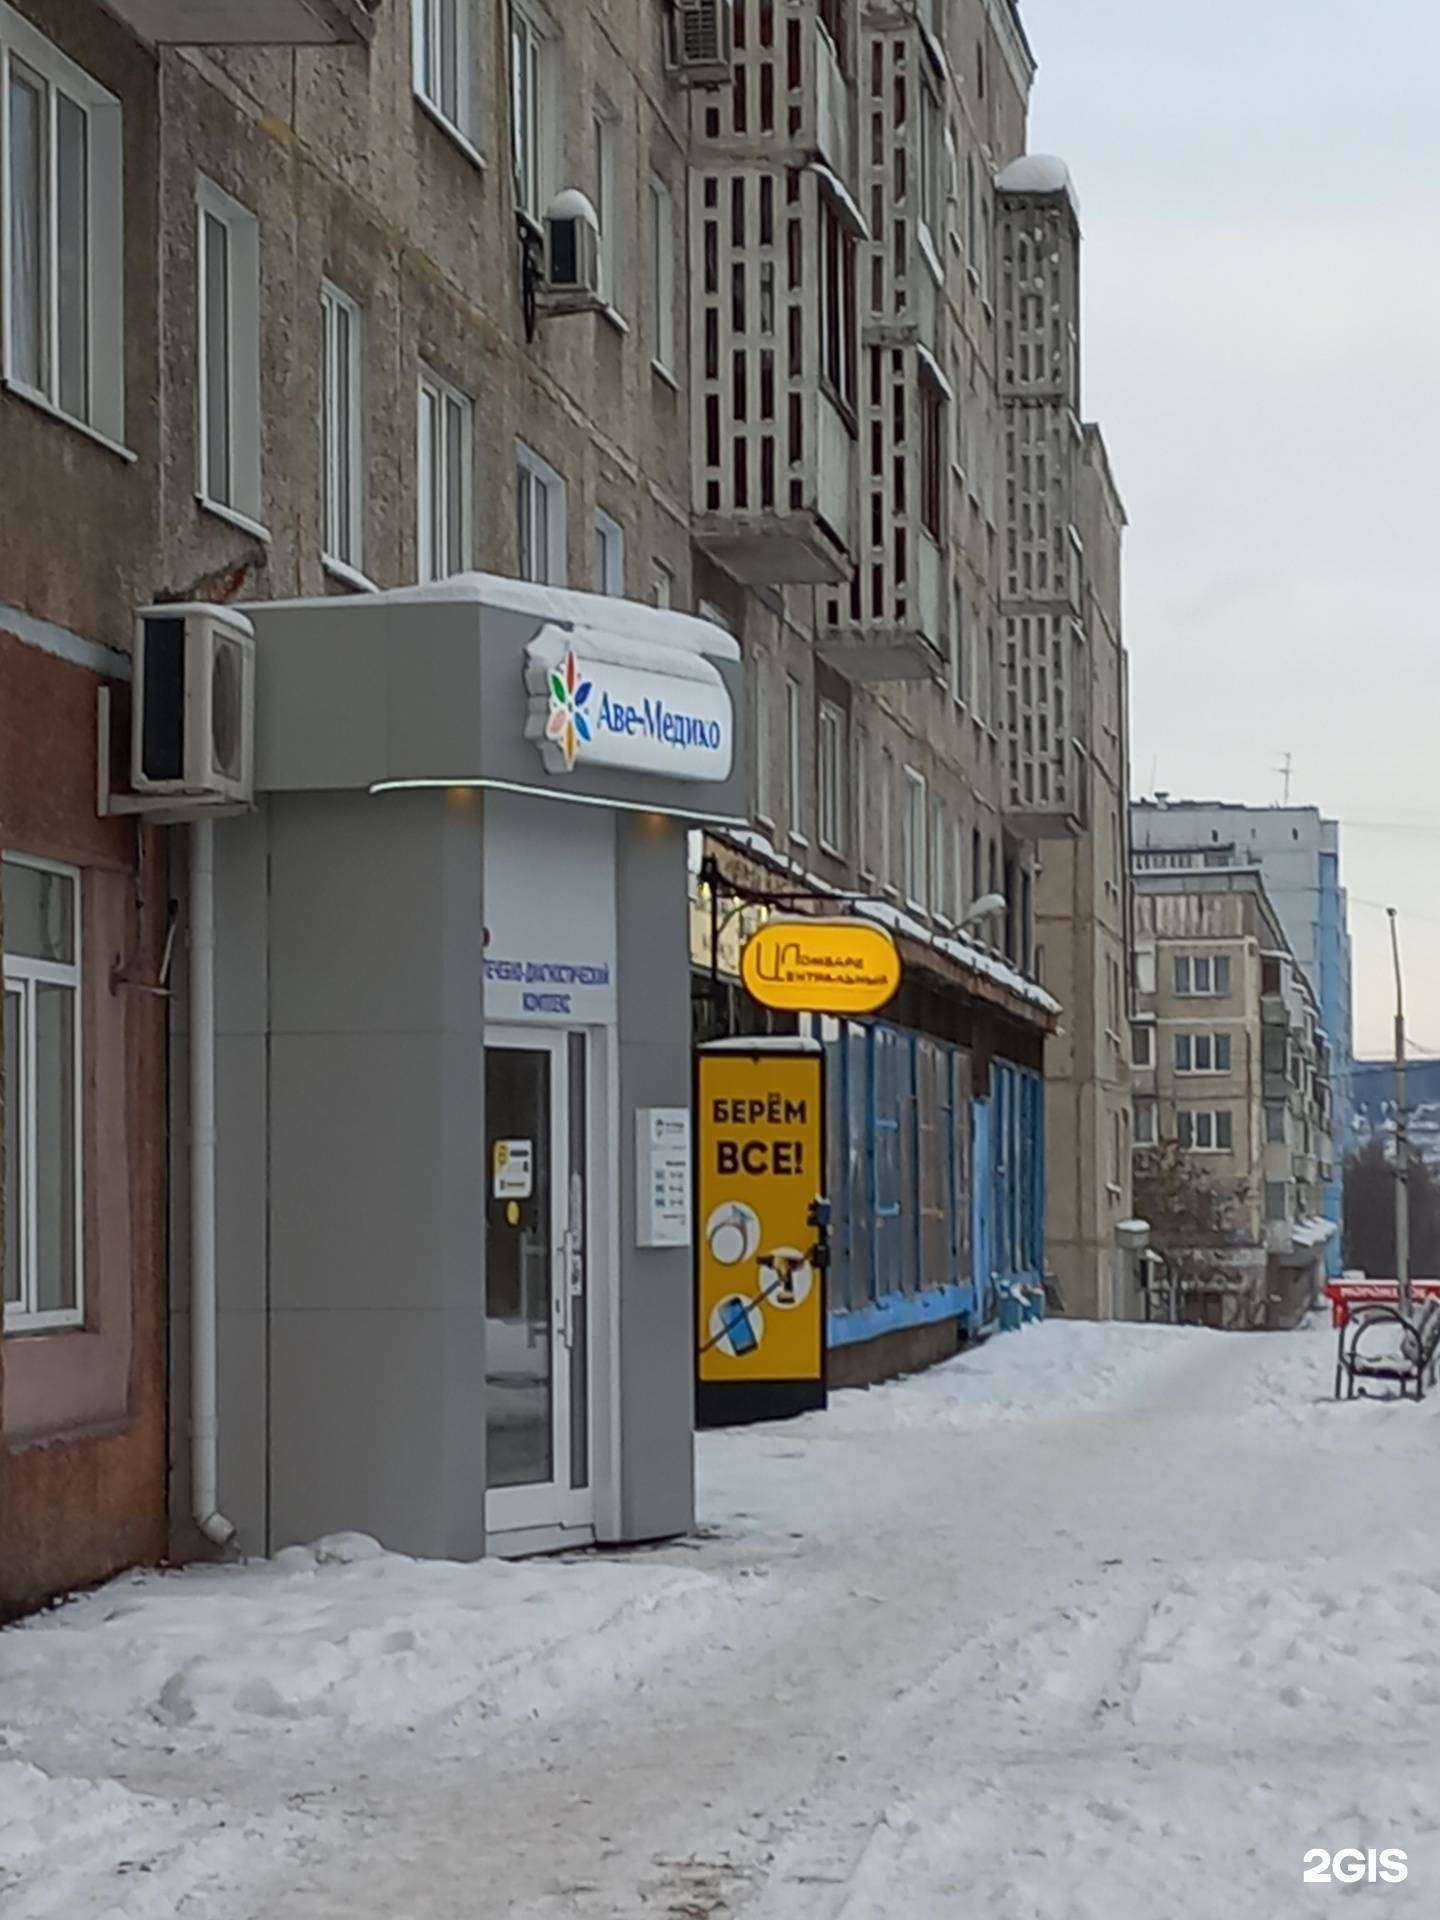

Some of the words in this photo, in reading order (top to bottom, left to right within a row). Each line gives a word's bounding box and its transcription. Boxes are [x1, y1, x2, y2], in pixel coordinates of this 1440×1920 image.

[597, 691, 720, 749] Аве-Медико
[713, 1092, 807, 1124] БЕРЁМ
[717, 1140, 804, 1175] ВСЕ!
